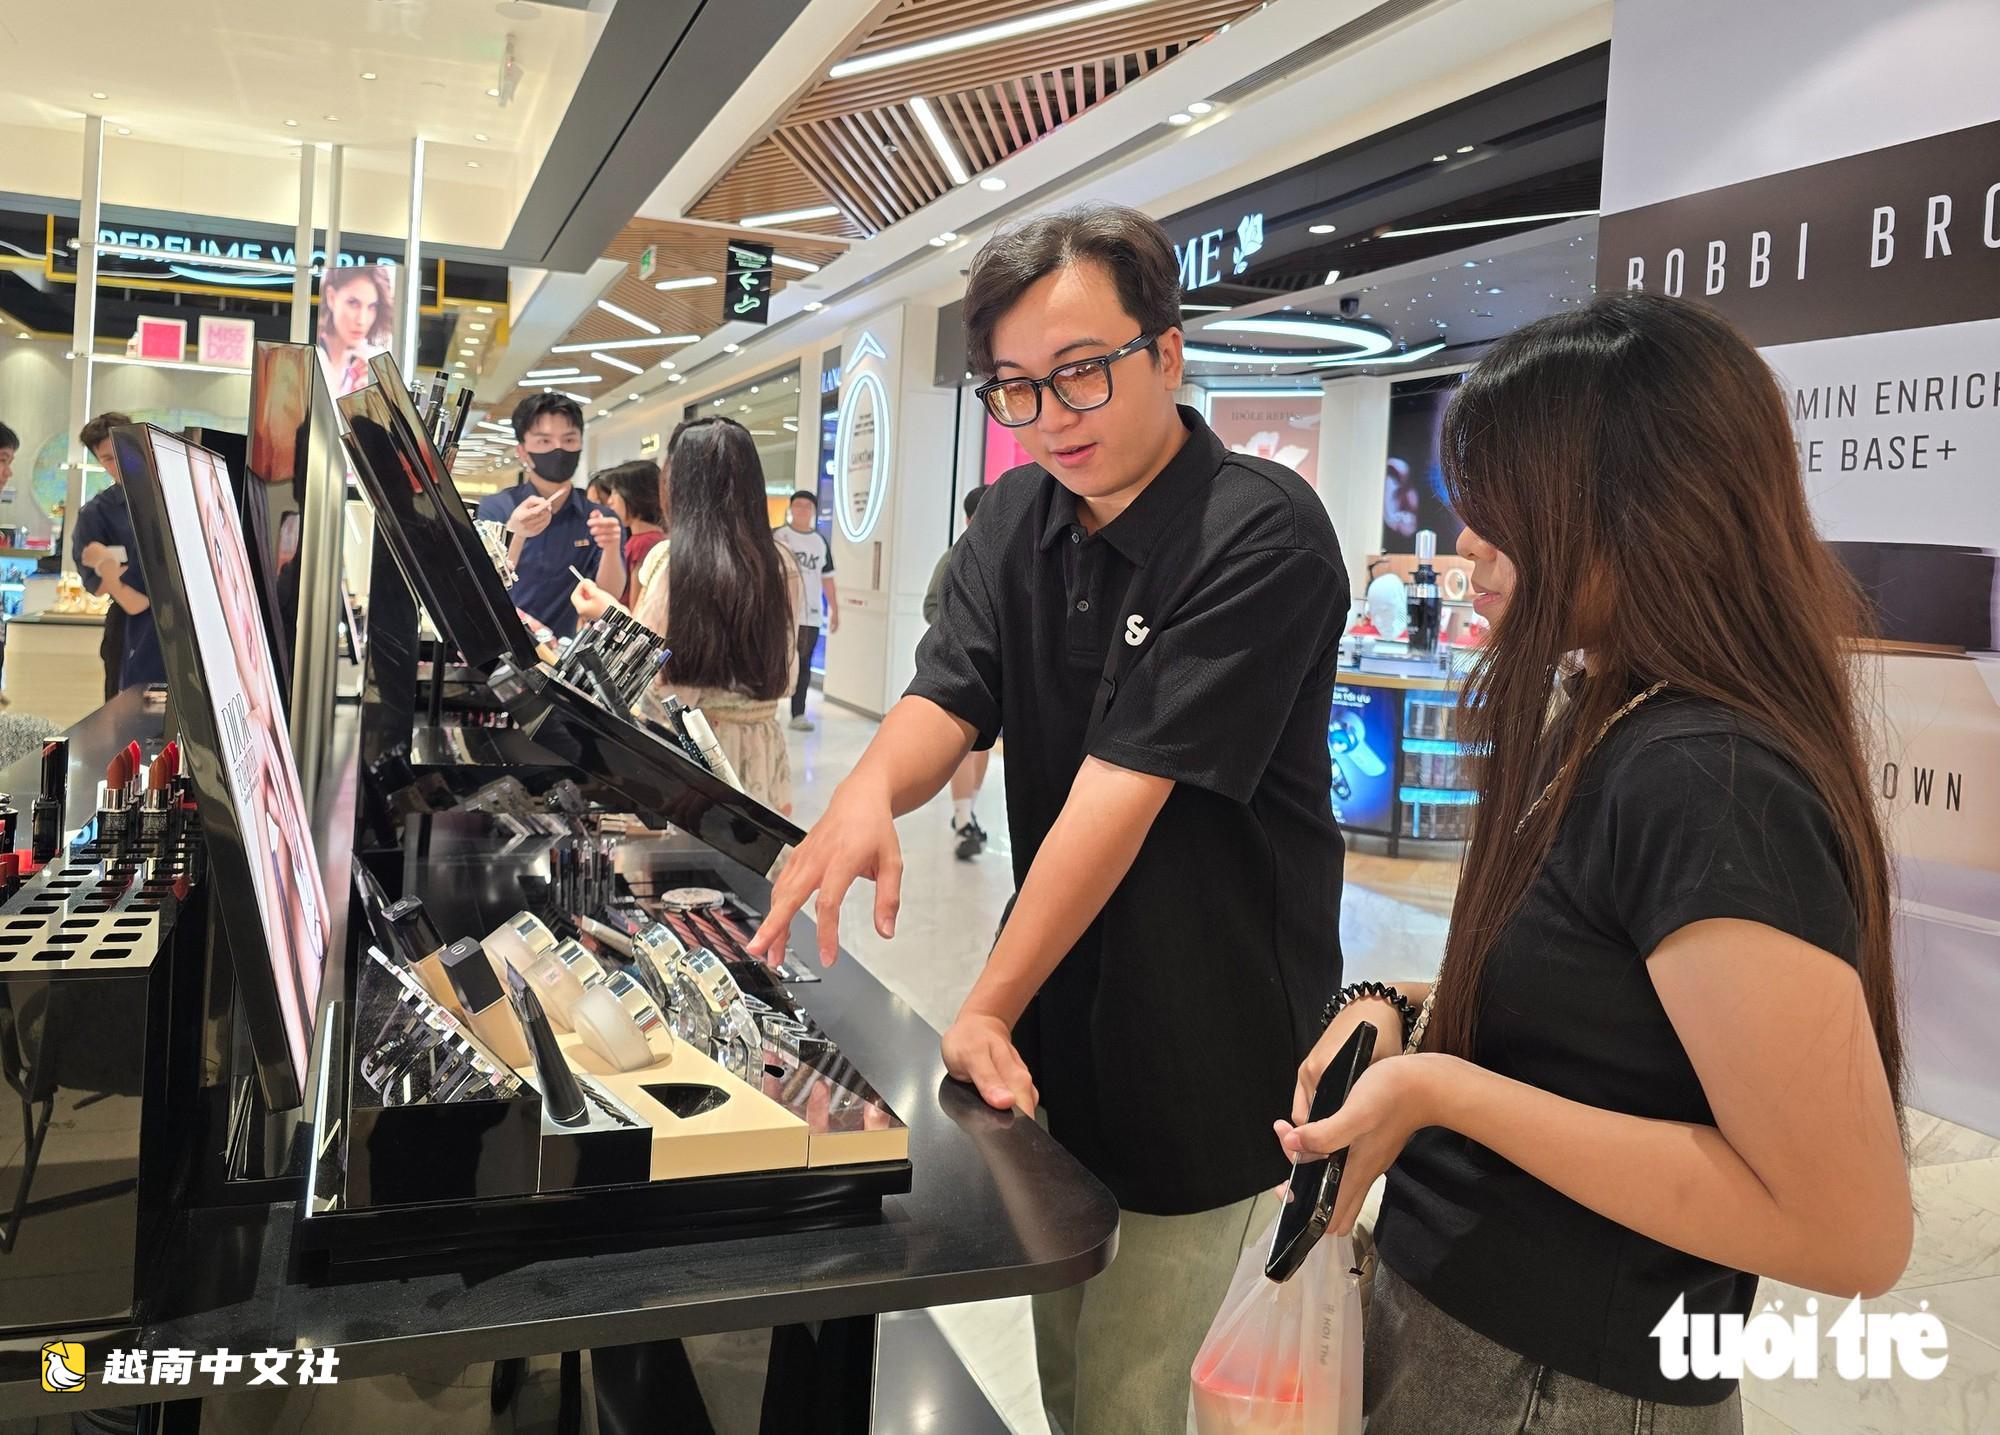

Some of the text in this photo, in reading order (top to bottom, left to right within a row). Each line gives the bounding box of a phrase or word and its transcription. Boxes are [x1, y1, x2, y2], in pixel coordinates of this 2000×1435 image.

[98, 229, 262, 266] PERFUME
[1627, 183, 2000, 298] BOBBI BRO
[1841, 435, 1957, 472] BASE+
[221, 692, 252, 764] DIOR
[1883, 762, 1962, 812] OWN
